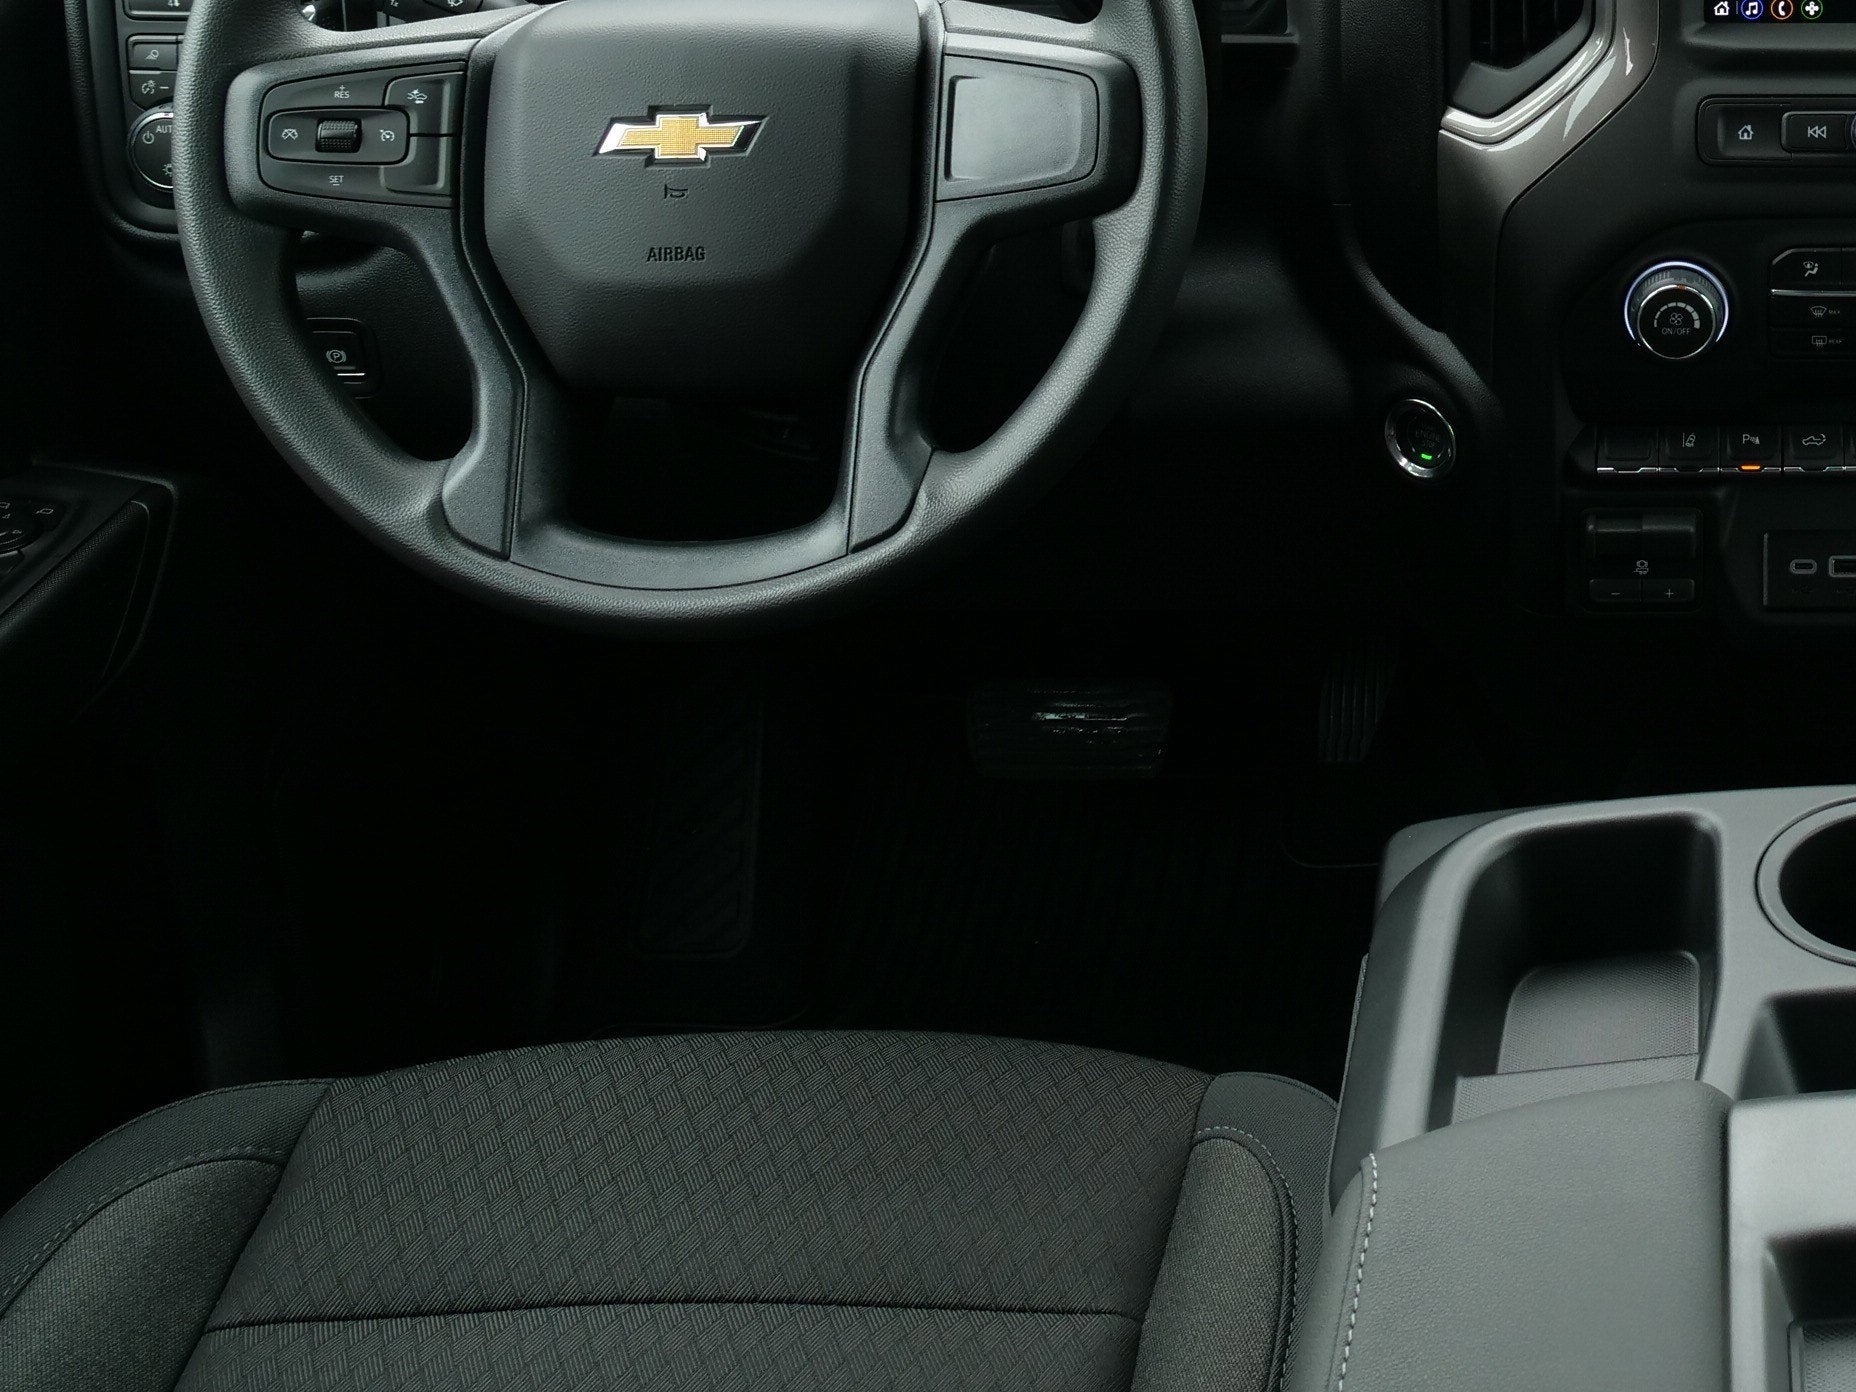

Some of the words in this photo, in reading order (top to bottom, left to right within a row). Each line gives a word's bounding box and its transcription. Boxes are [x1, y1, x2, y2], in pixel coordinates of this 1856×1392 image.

[334, 90, 350, 99] RES
[155, 125, 172, 133] AUT
[329, 175, 345, 183] SET
[647, 246, 706, 263] AIRBAG
[1661, 327, 1691, 335] ON/OFF
